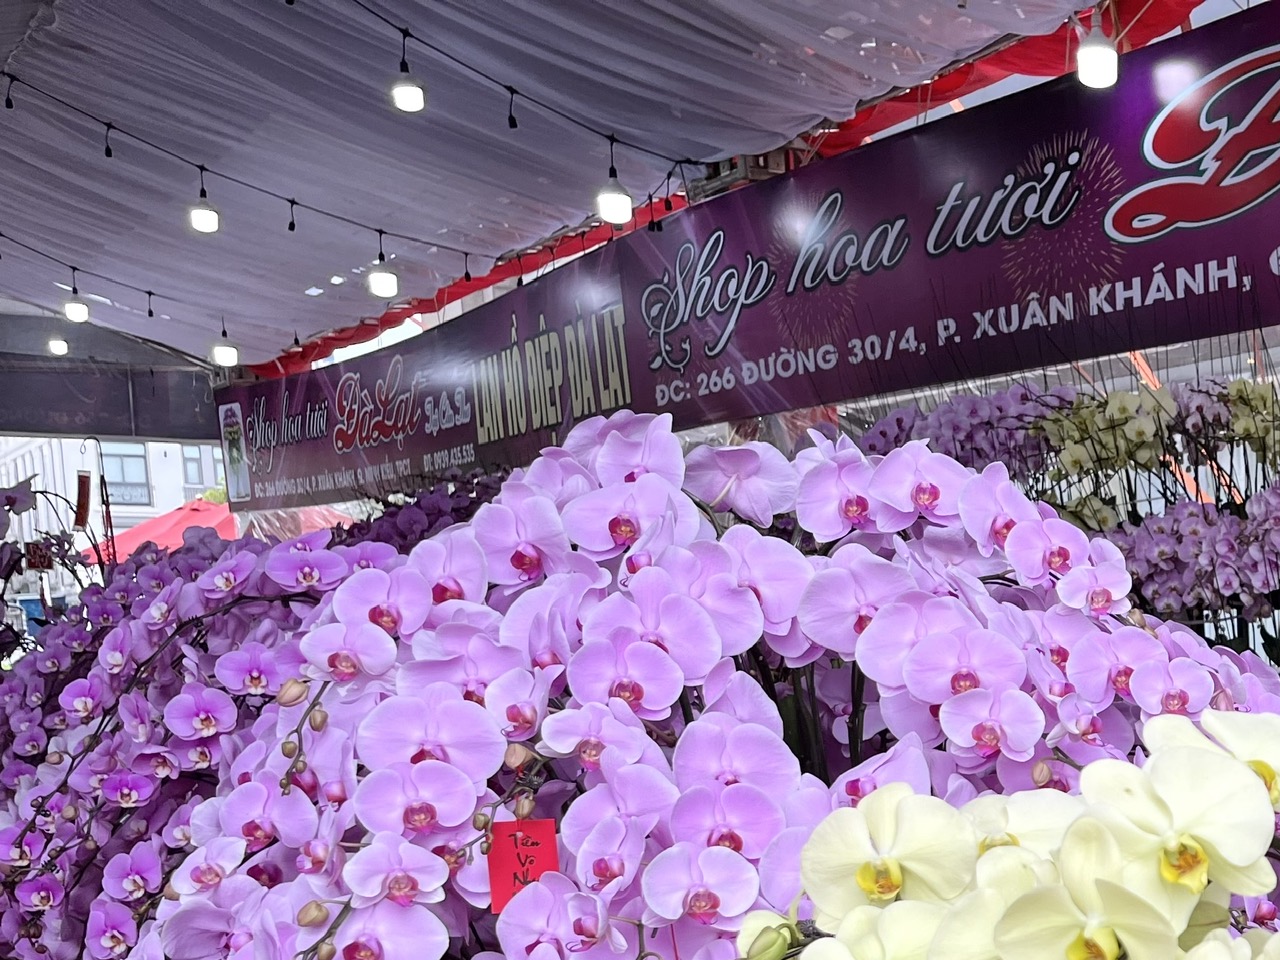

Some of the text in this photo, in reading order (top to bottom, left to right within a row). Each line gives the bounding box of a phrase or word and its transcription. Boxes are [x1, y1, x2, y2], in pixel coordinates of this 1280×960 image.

[641, 230, 776, 372] Shop
[785, 192, 909, 293] hoa
[926, 151, 1080, 255] tươi
[655, 379, 692, 407] ĐC:
[697, 366, 736, 397] 266
[741, 344, 839, 387] ĐƯỜNG
[847, 326, 928, 365] 30/4,
[936, 317, 962, 347] P.
[972, 291, 1075, 341] XUÂN
[1088, 255, 1252, 317] KHÁNH,
[247, 396, 278, 474] Shop
[471, 354, 505, 445] LAN
[501, 314, 527, 437] HỒ
[525, 314, 563, 446] ĐIỆP
